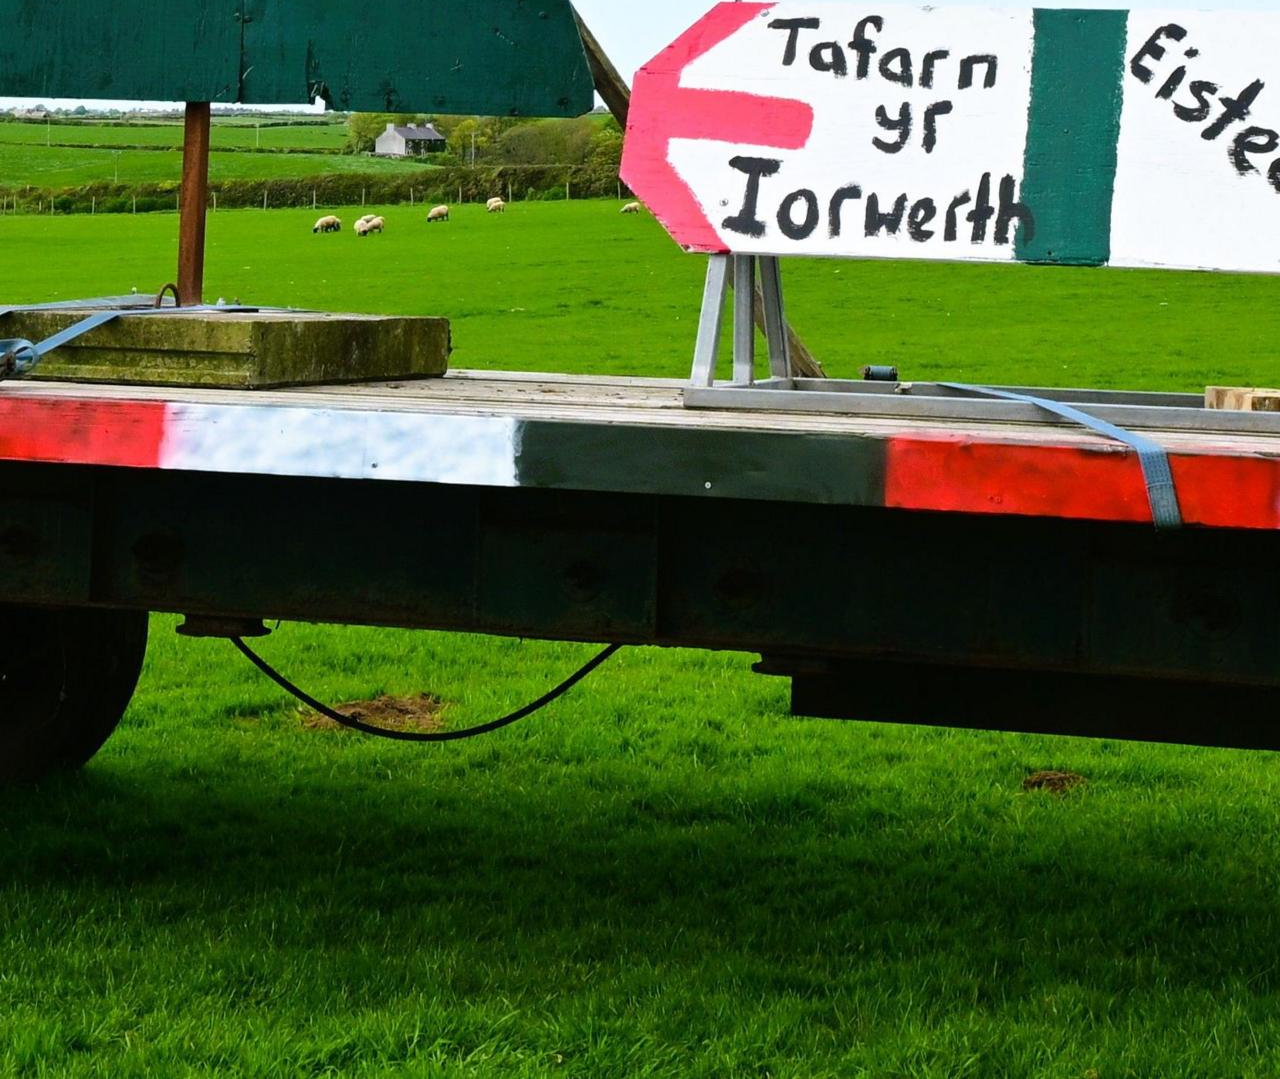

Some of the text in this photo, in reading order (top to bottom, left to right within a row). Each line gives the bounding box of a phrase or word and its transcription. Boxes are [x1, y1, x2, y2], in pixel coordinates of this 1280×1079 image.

[768, 16, 996, 89] Tafarn
[873, 101, 952, 153] yr
[723, 156, 1035, 245] Iorwerth
